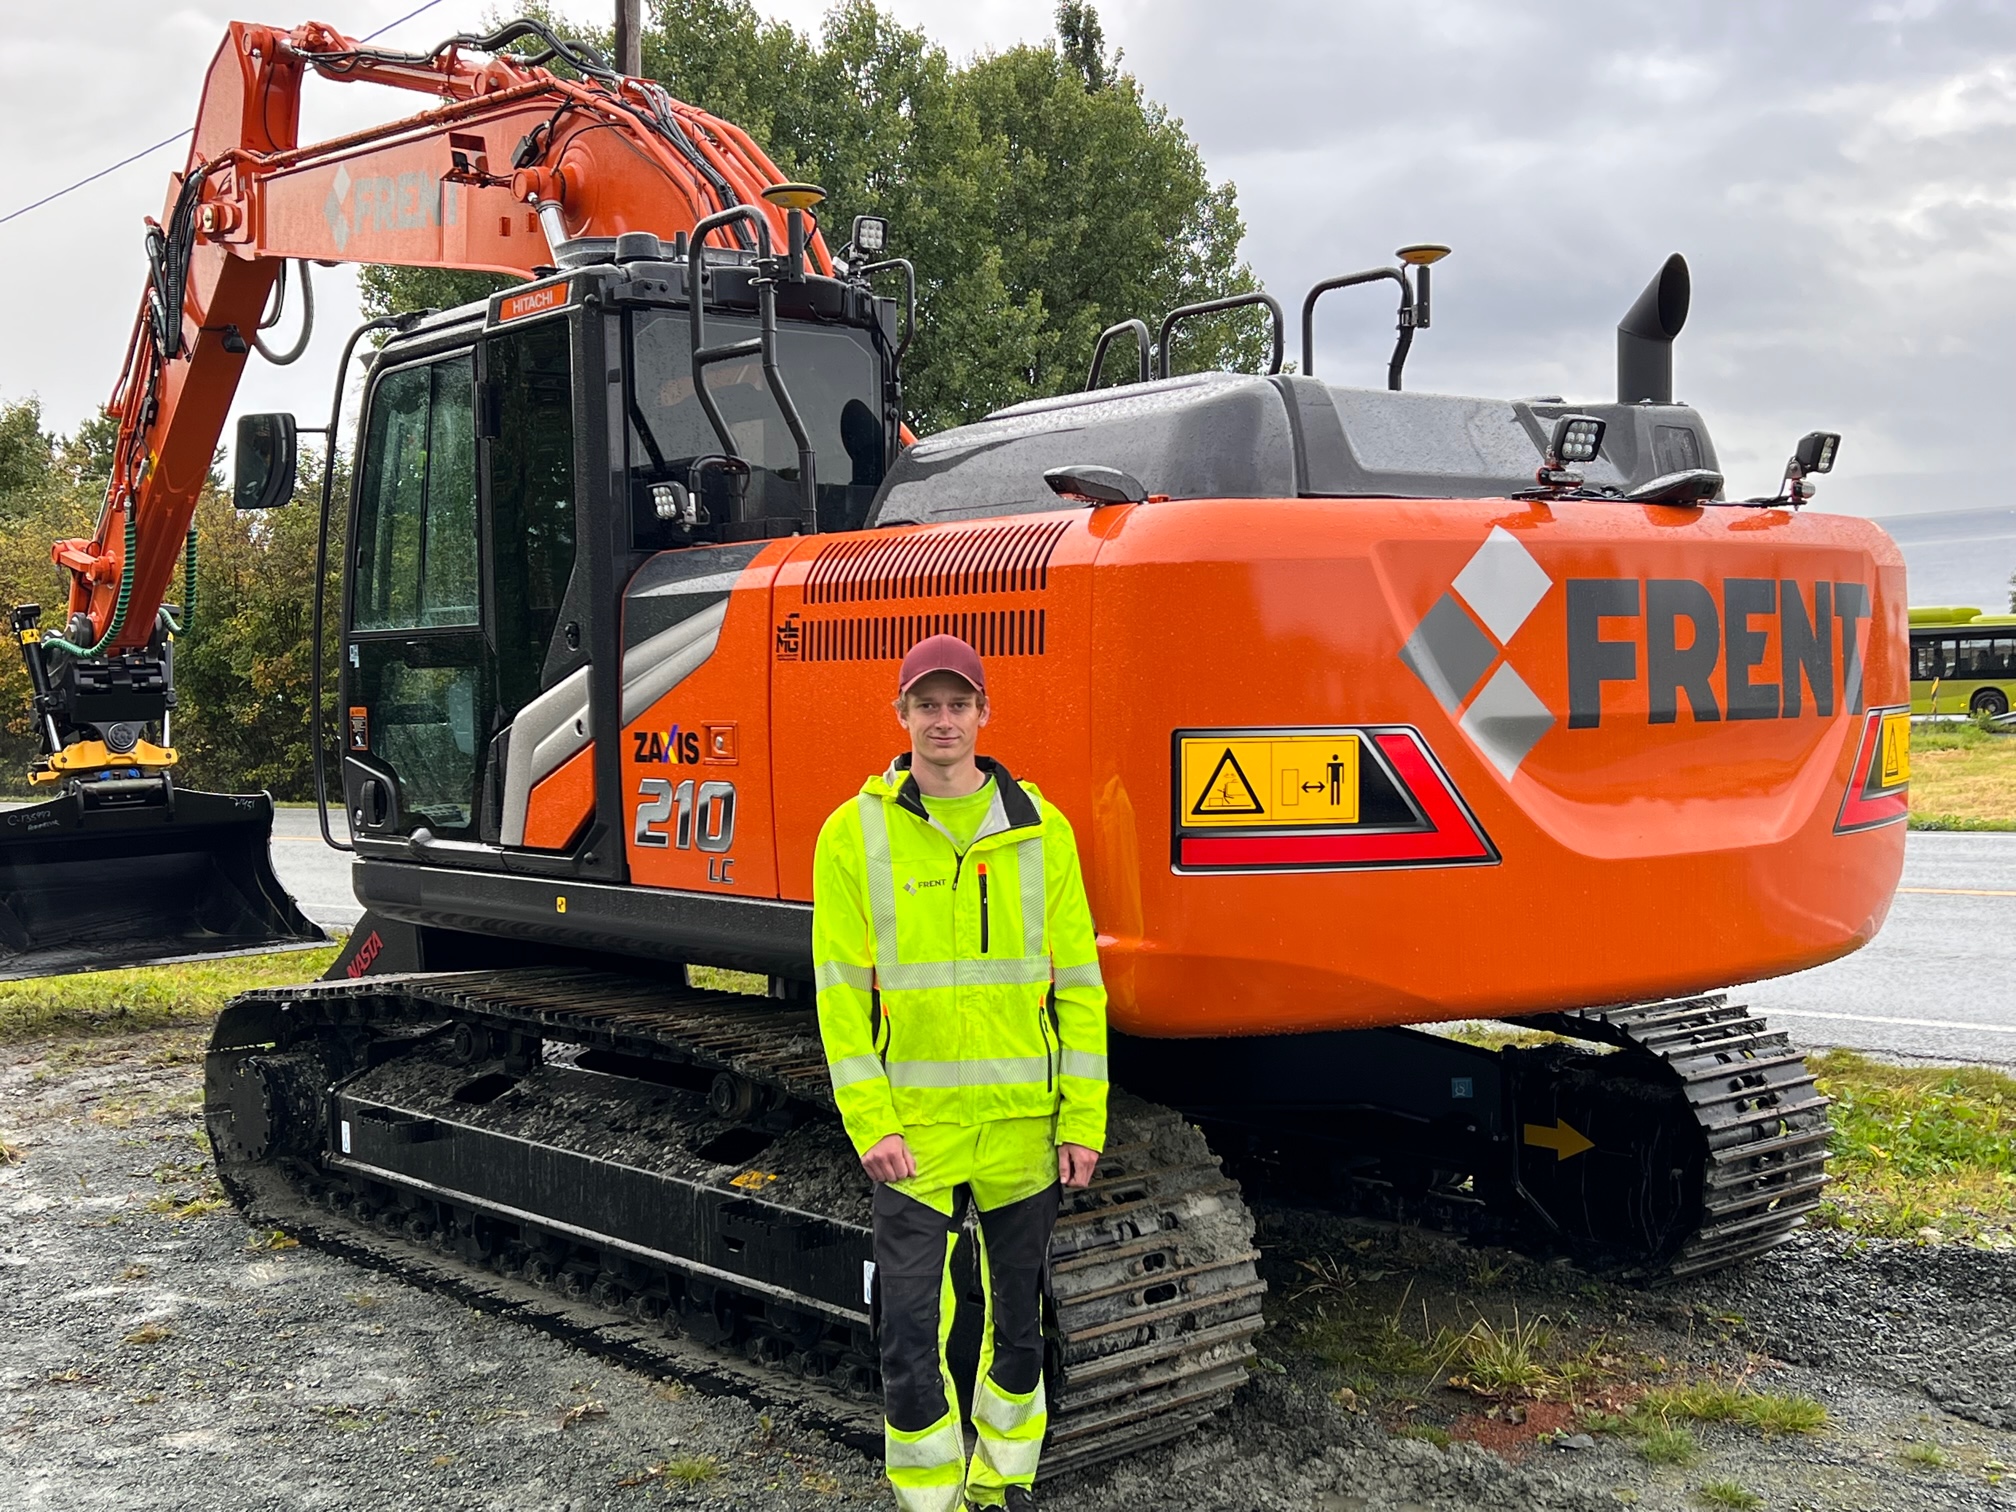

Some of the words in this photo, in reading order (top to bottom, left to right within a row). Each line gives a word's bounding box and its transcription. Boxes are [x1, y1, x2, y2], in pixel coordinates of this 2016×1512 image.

[512, 290, 553, 314] HITACHI
[1566, 577, 1873, 729] FRENT
[634, 724, 699, 765] ZAXIS
[634, 777, 737, 853] 210
[707, 856, 735, 884] LC
[918, 879, 947, 889] FRENT
[346, 929, 384, 979] NASTA
